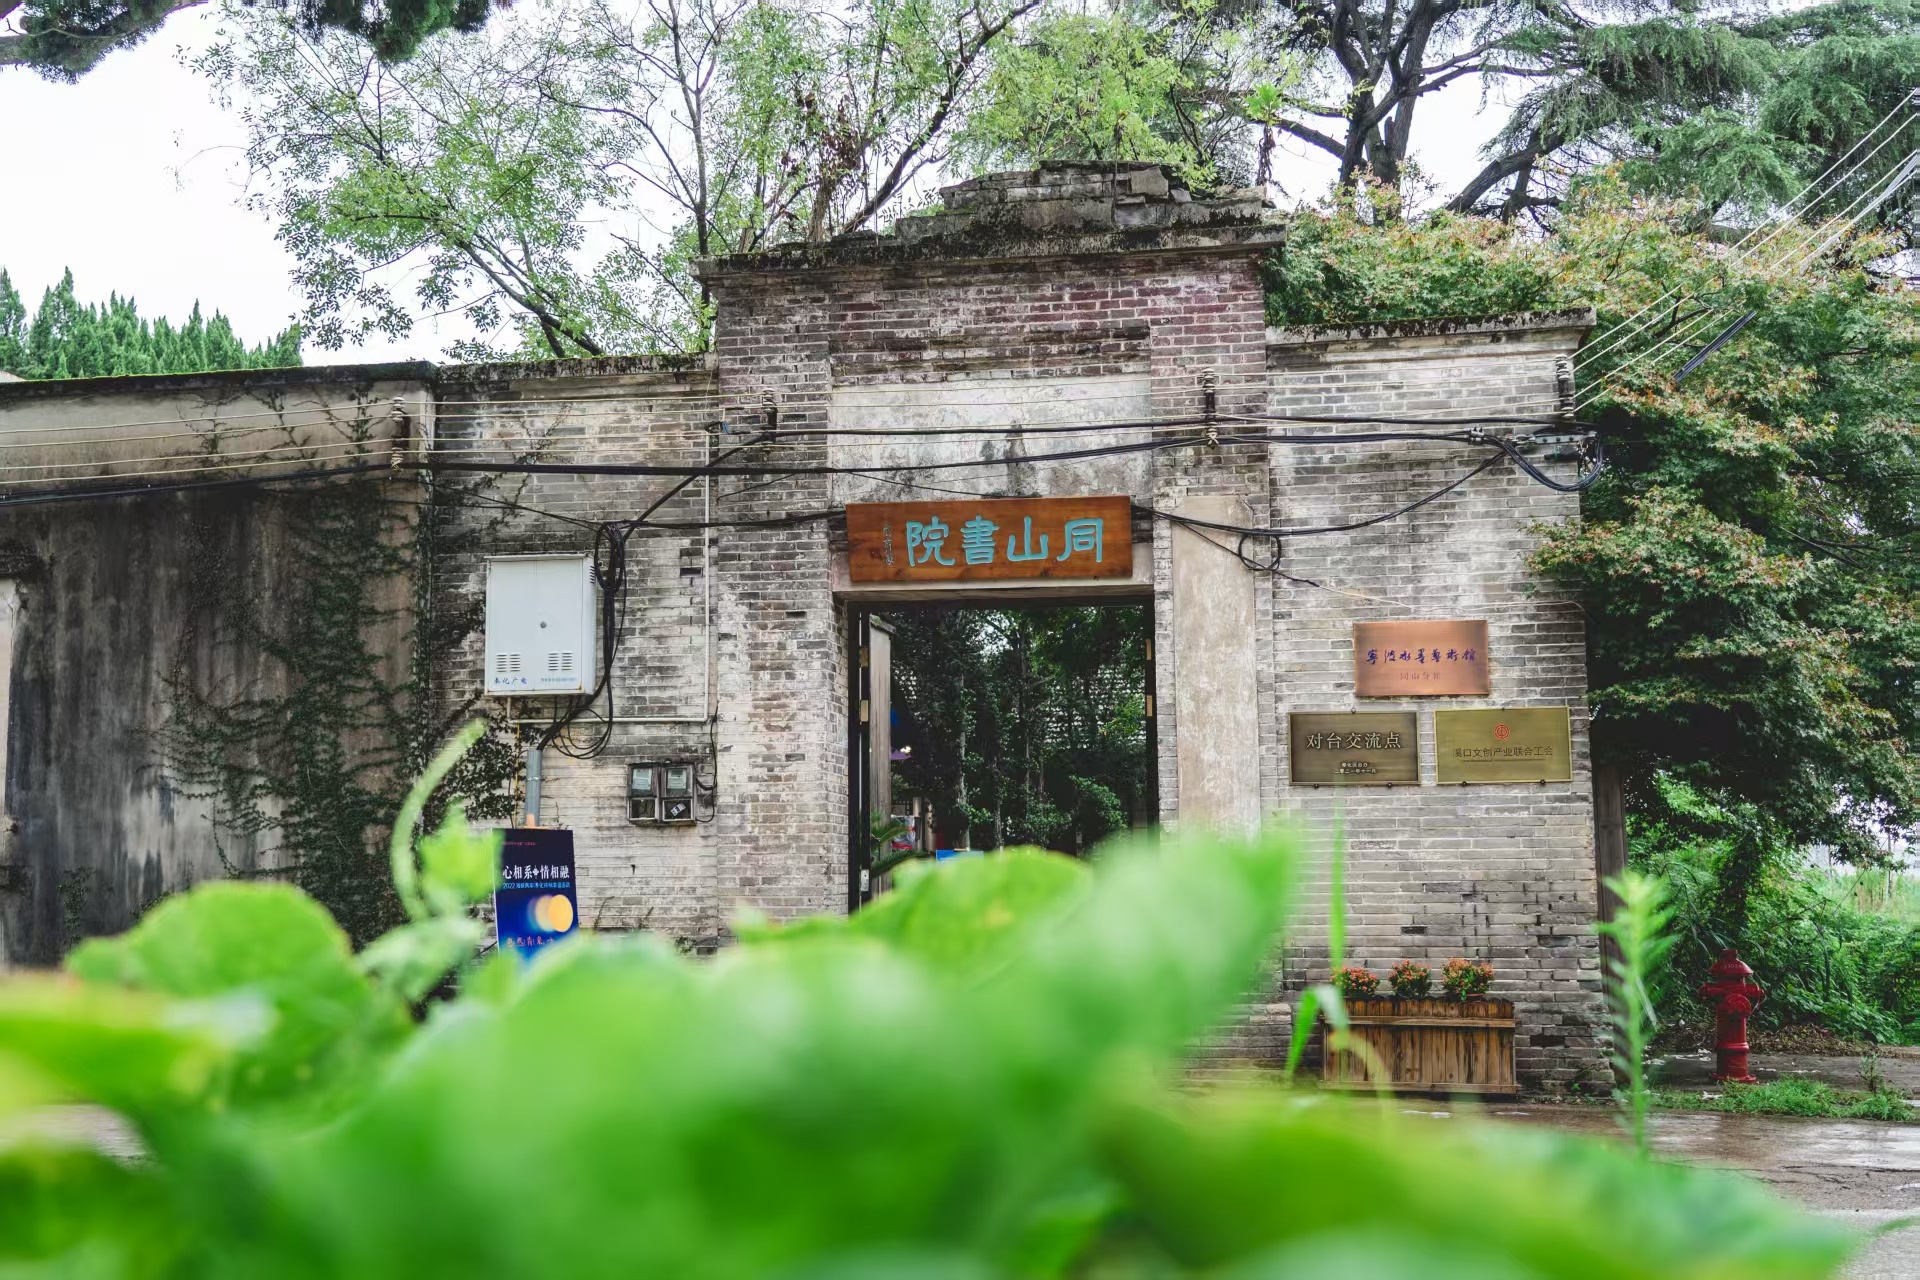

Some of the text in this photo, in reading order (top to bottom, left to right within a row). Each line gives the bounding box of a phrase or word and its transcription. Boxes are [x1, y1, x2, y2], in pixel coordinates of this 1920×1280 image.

[1305, 731, 1401, 749] 对台交流点
